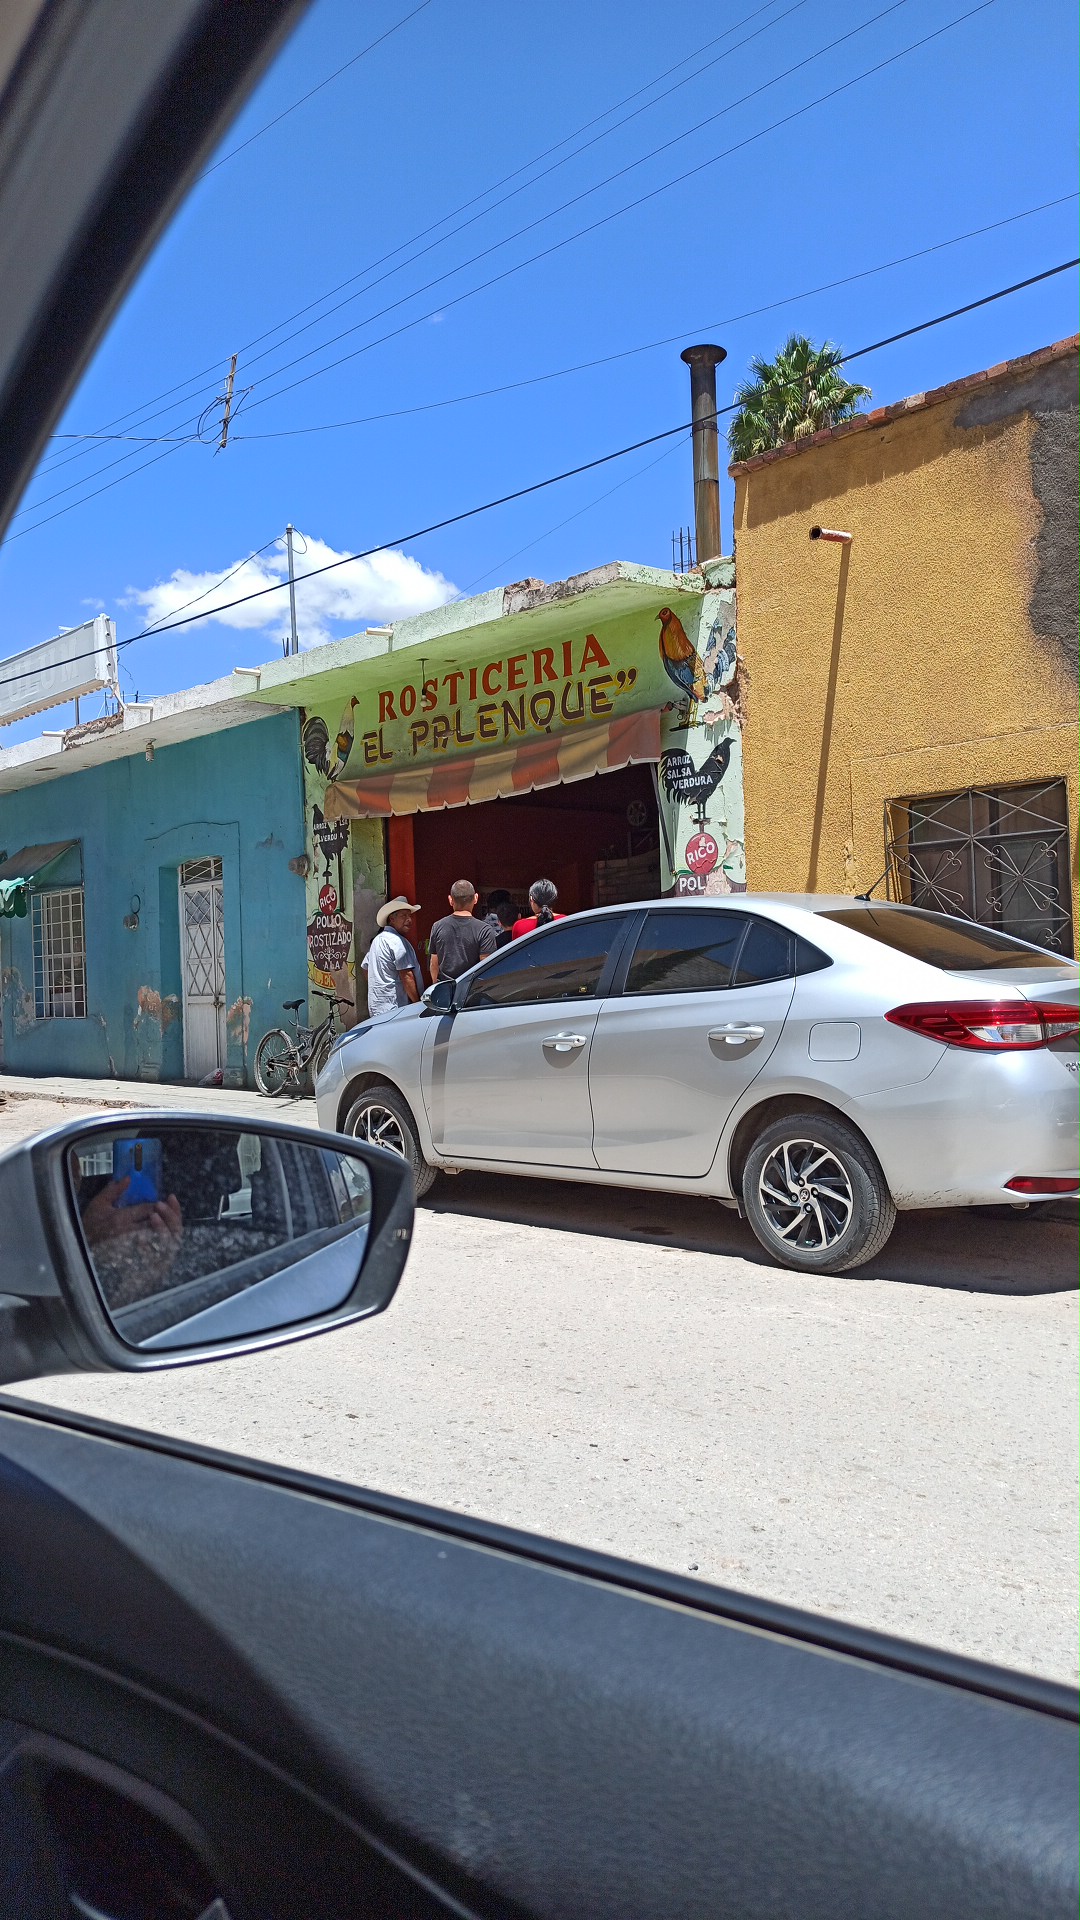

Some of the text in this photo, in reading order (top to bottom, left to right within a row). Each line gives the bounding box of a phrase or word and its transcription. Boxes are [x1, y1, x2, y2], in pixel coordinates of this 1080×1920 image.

[378, 633, 610, 723] ROSTICERIA
[362, 726, 393, 765] EL
[667, 755, 691, 768] ARROZ
[667, 767, 692, 780] SALSA
[673, 775, 713, 790] VERDURA
[320, 832, 344, 842] VERDUA
[687, 841, 715, 865] RICO
[319, 892, 336, 908] RICO
[316, 914, 342, 928] POLLO
[308, 931, 352, 949] ROSTIZADO
